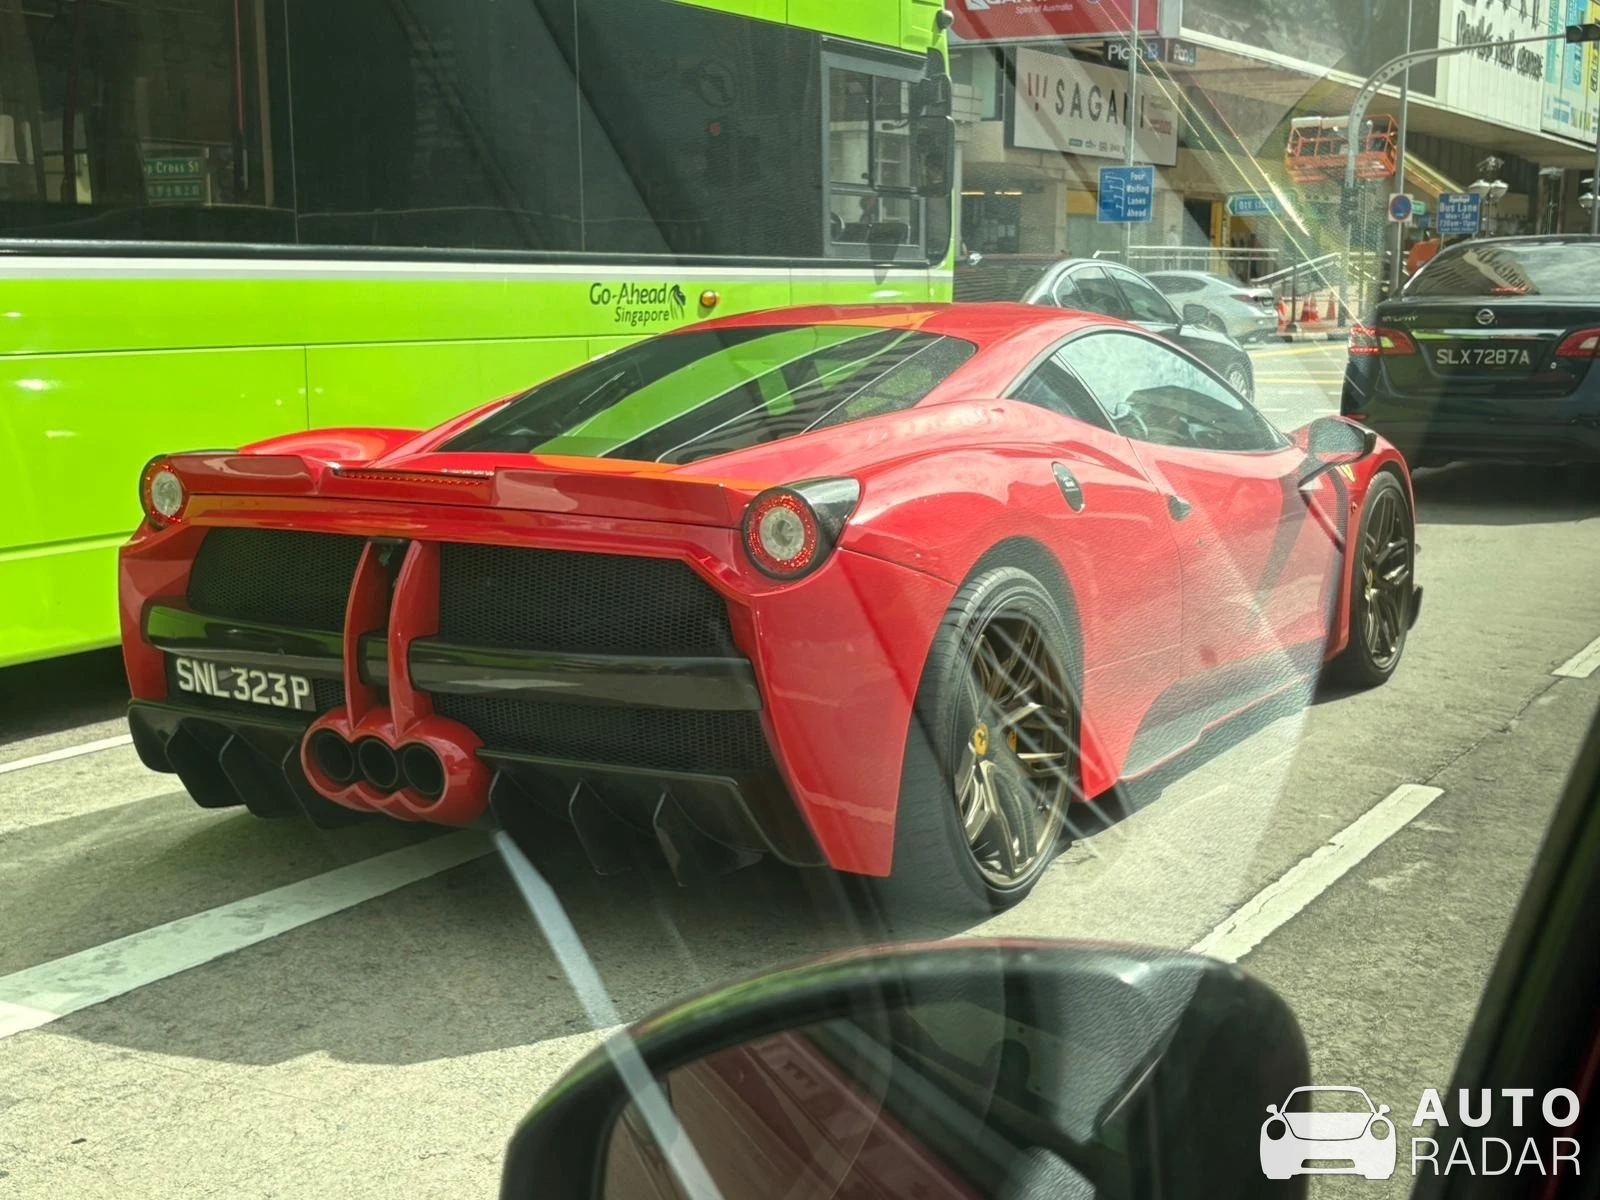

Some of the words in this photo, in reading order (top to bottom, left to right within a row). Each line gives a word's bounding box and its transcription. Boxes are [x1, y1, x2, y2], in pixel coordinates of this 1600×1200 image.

[156, 161, 185, 173] Cross
[188, 160, 199, 173] St
[1126, 184, 1150, 194] Waiting
[1127, 197, 1146, 205] Lanes
[1126, 207, 1146, 217] Ahead
[1440, 203, 1455, 212] Bus
[1457, 203, 1477, 213] Lane
[589, 282, 667, 305] Go-Ahead
[614, 306, 670, 327] Singapore
